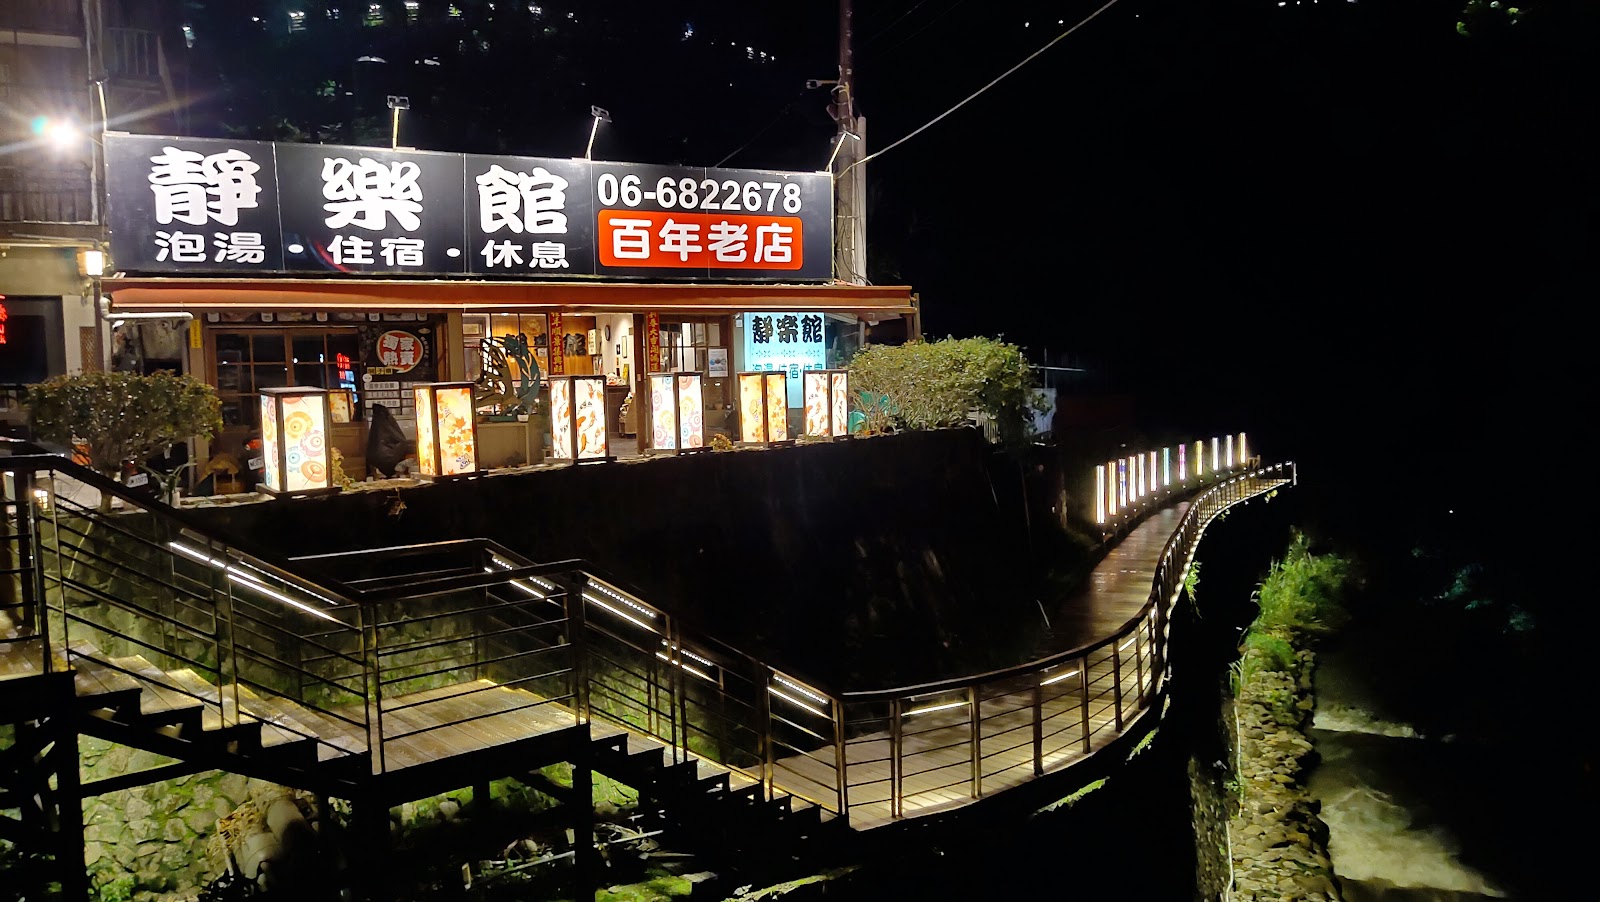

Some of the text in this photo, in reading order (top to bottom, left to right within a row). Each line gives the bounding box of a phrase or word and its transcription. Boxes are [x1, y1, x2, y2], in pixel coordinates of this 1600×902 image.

[148, 148, 568, 234] 靜樂館
[597, 173, 803, 214] 06-6822678
[154, 230, 569, 269] 泡湯 住宿 休息
[608, 218, 793, 263] 百年老店
